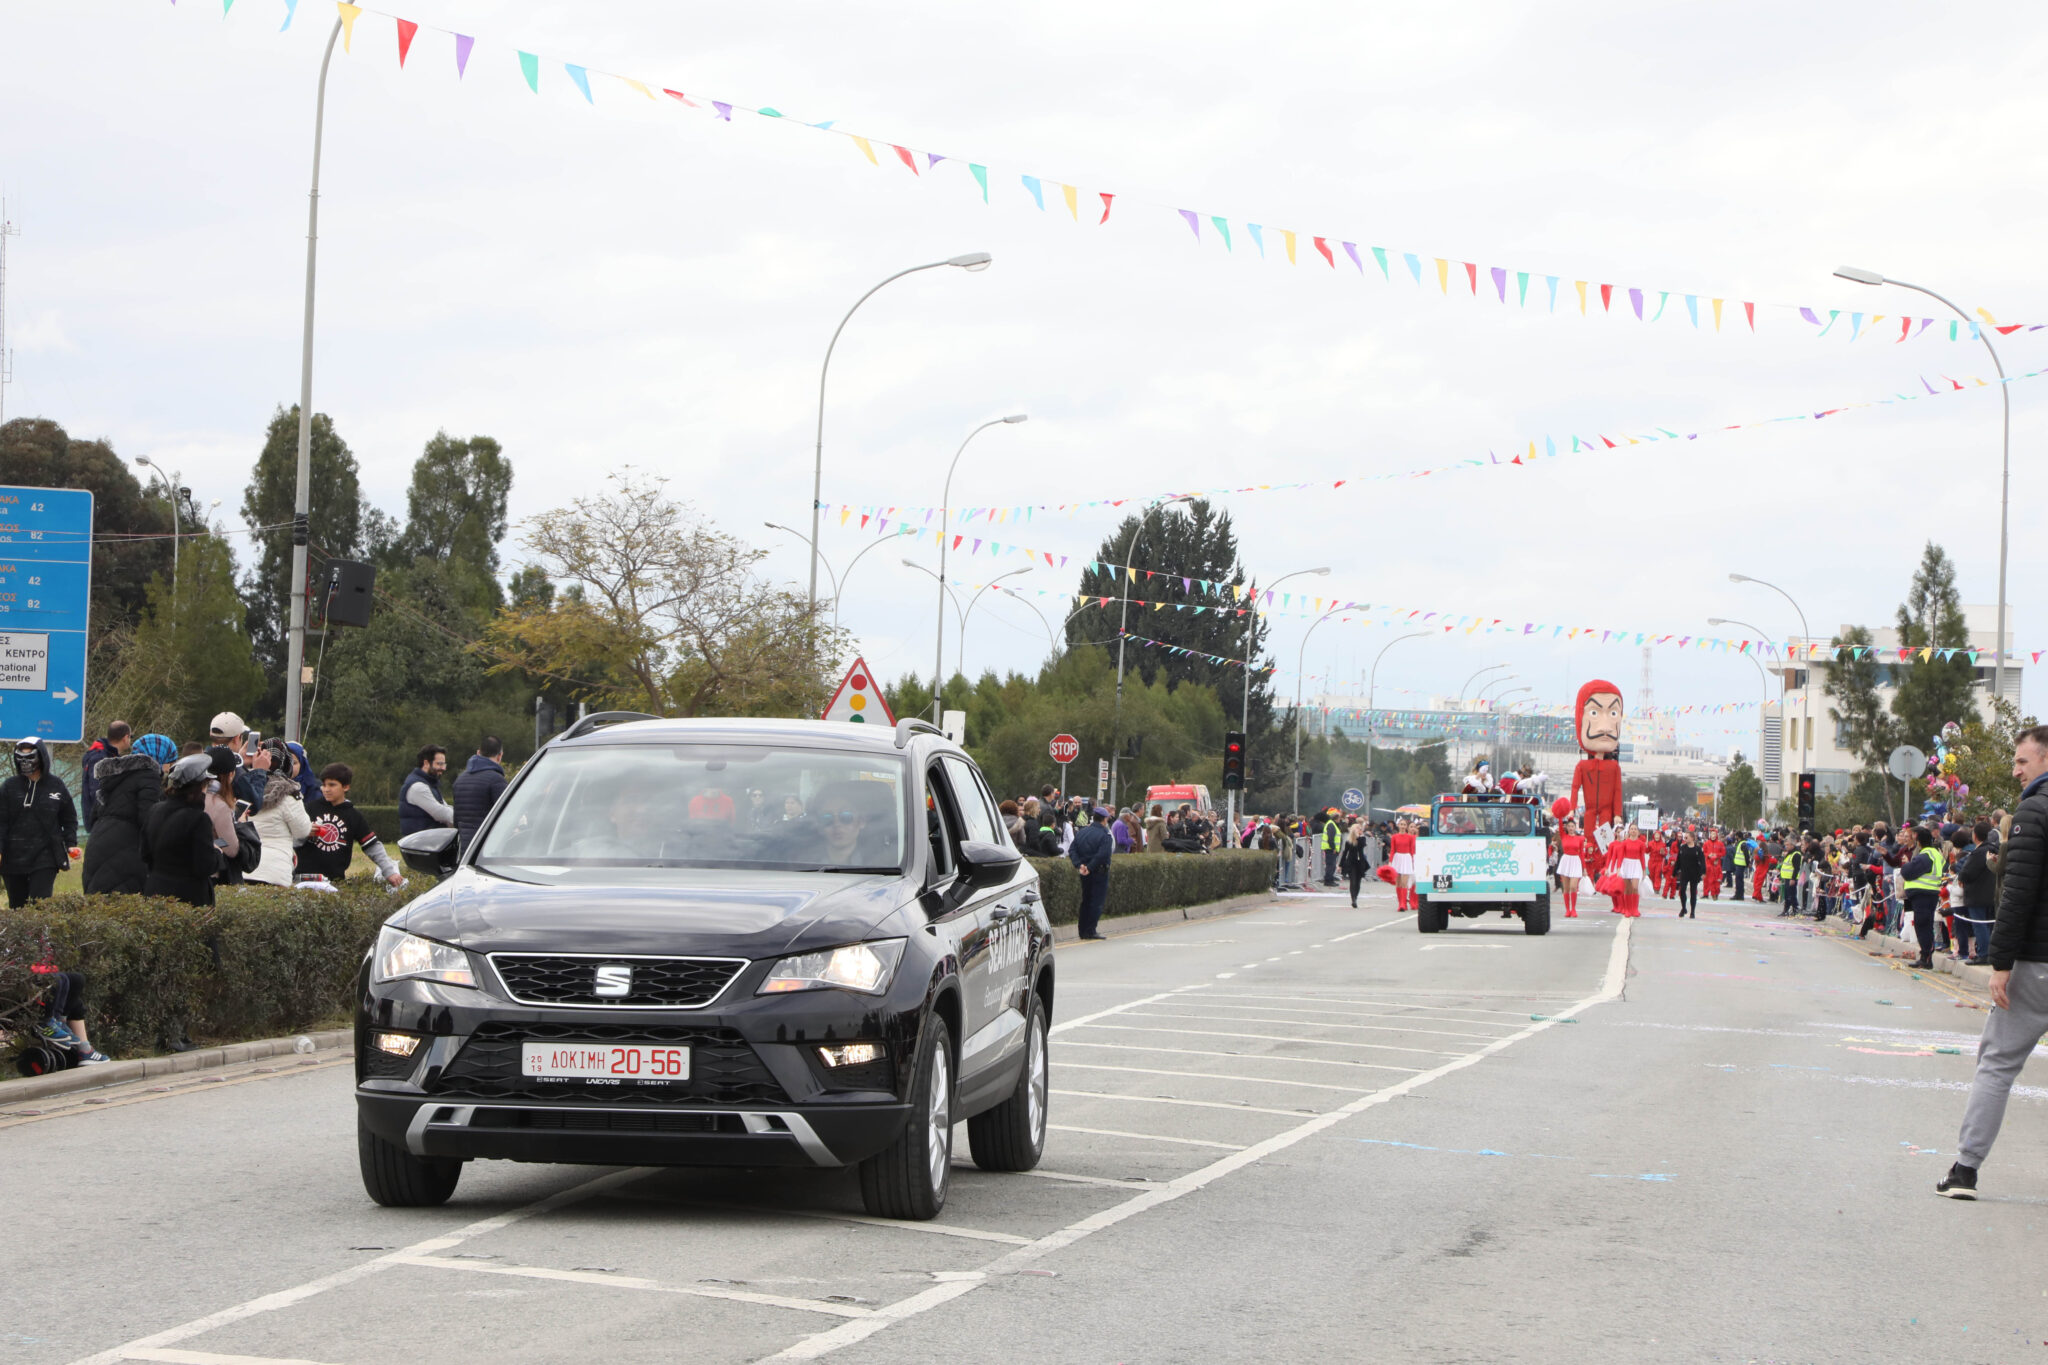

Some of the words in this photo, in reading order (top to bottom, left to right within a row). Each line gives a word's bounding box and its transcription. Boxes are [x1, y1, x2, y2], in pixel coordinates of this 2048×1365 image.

[30, 502, 44, 512] 42
[30, 530, 43, 540] 82
[28, 576, 41, 586] 42
[27, 599, 41, 609] 82
[5, 649, 46, 659] ΚΕΝΤΡΟ
[0, 673, 31, 682] Centre
[1051, 742, 1077, 756] STOP
[551, 1051, 605, 1070] ΔΟΚΙΜΗ
[611, 1048, 681, 1075] 20-56
